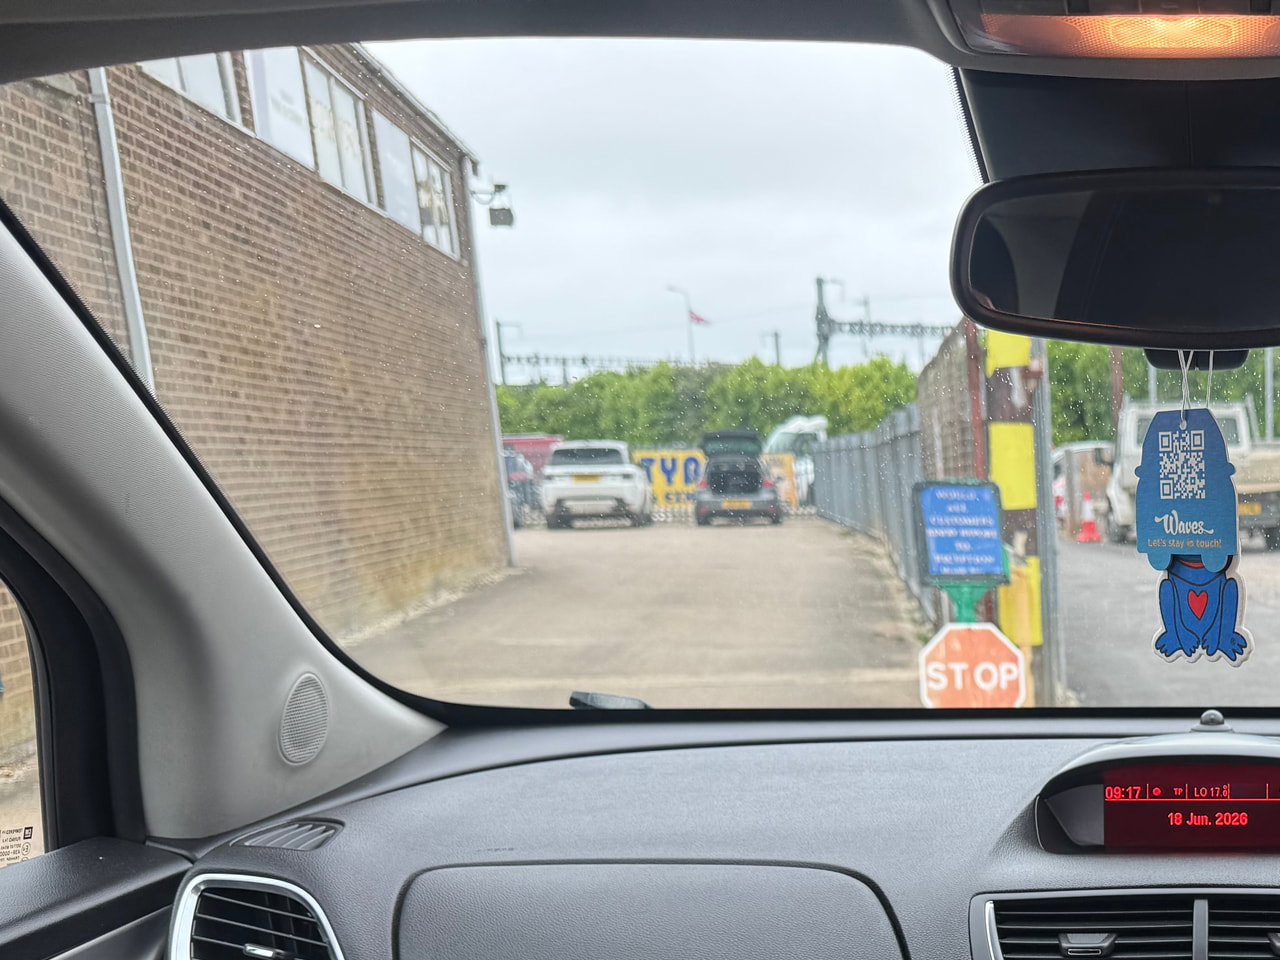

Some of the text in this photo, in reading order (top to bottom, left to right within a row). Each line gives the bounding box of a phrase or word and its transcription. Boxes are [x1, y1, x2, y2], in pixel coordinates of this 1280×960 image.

[1154, 509, 1214, 536] Waves
[1147, 538, 1167, 547] Let's
[1168, 539, 1185, 549] stay
[1196, 538, 1222, 548] touch!
[926, 661, 1019, 691] STOP
[1105, 786, 1141, 799] 09:17
[1173, 787, 1184, 796] TP
[1167, 812, 1248, 826] 18 Jun. 2026
